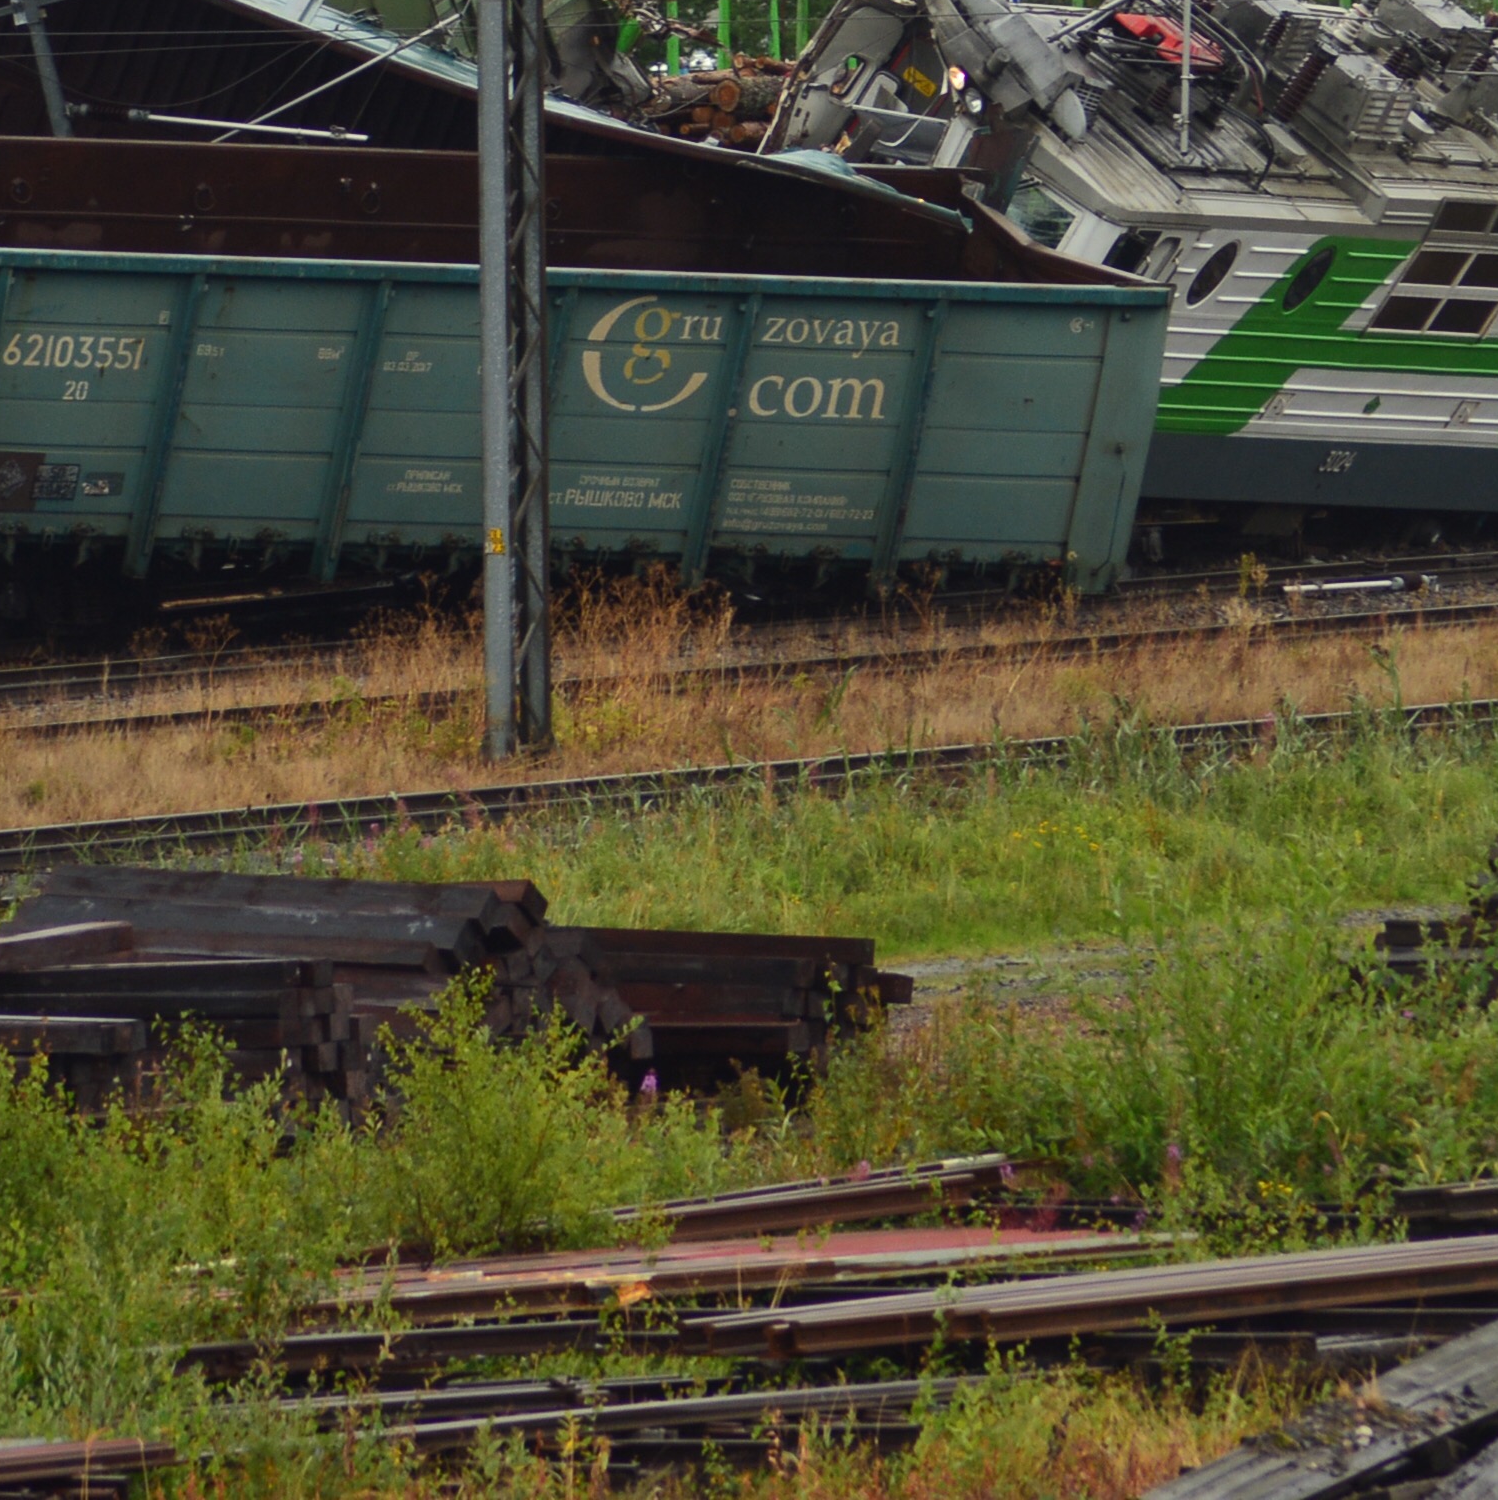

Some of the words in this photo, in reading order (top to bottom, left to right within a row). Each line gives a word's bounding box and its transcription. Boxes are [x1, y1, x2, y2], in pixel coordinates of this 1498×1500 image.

[2, 332, 145, 371] 62103551
[61, 380, 89, 401] 20
[1318, 450, 1358, 472] 3024
[647, 490, 683, 509] МСК
